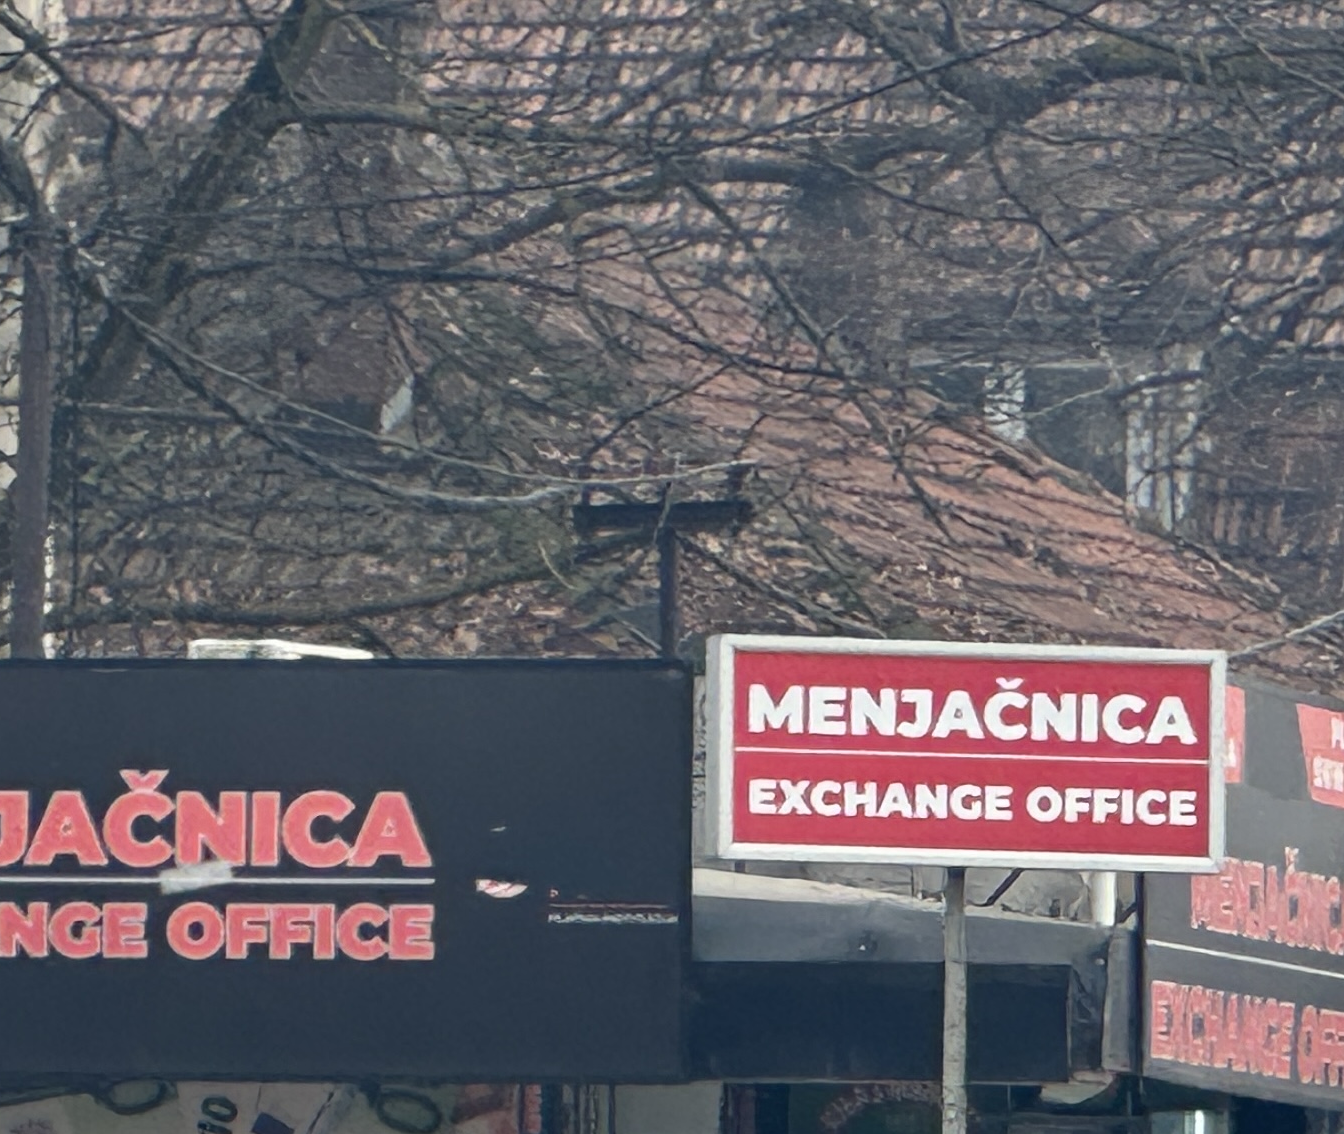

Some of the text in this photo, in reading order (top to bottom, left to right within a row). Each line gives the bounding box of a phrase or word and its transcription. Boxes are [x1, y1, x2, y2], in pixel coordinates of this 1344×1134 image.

[748, 677, 1198, 745] MENJAČNICA
[748, 778, 1198, 827] EXCHANGE OFFICE
[166, 902, 436, 961] OFFICE
[1150, 980, 1295, 1079] EXCHANGE
